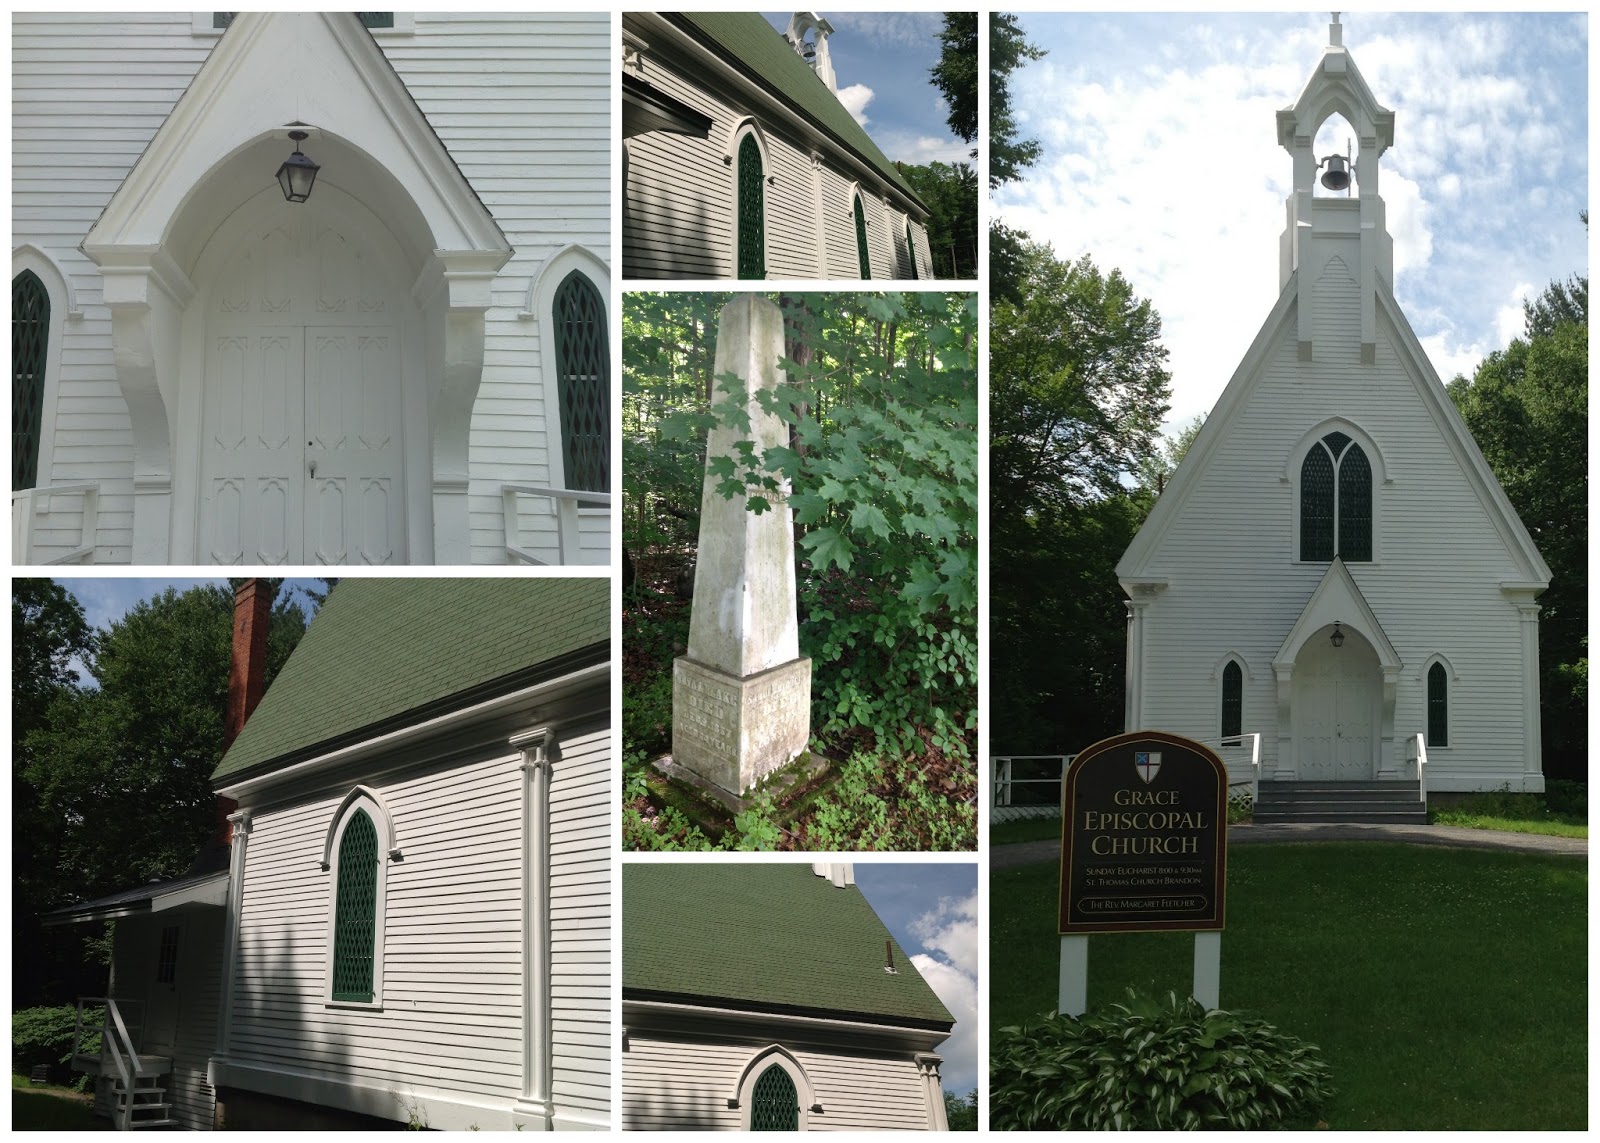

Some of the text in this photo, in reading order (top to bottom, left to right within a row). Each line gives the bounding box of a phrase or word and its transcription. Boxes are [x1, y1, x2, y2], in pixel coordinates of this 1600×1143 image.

[689, 695, 724, 720] DIED
[1114, 789, 1180, 806] GRACE
[1083, 811, 1209, 831] EPISCOPAL
[1091, 835, 1199, 855] CHURCH
[1086, 867, 1117, 876] SUNDAY
[1117, 867, 1158, 875] EUCHARIST
[1098, 878, 1129, 886] THOMAS
[1130, 877, 1163, 886] CHURCH
[1164, 877, 1201, 885] BRANDON
[1091, 900, 1103, 909] THE
[1120, 900, 1159, 908] MARGARET
[1161, 899, 1195, 907] FLETCHER
